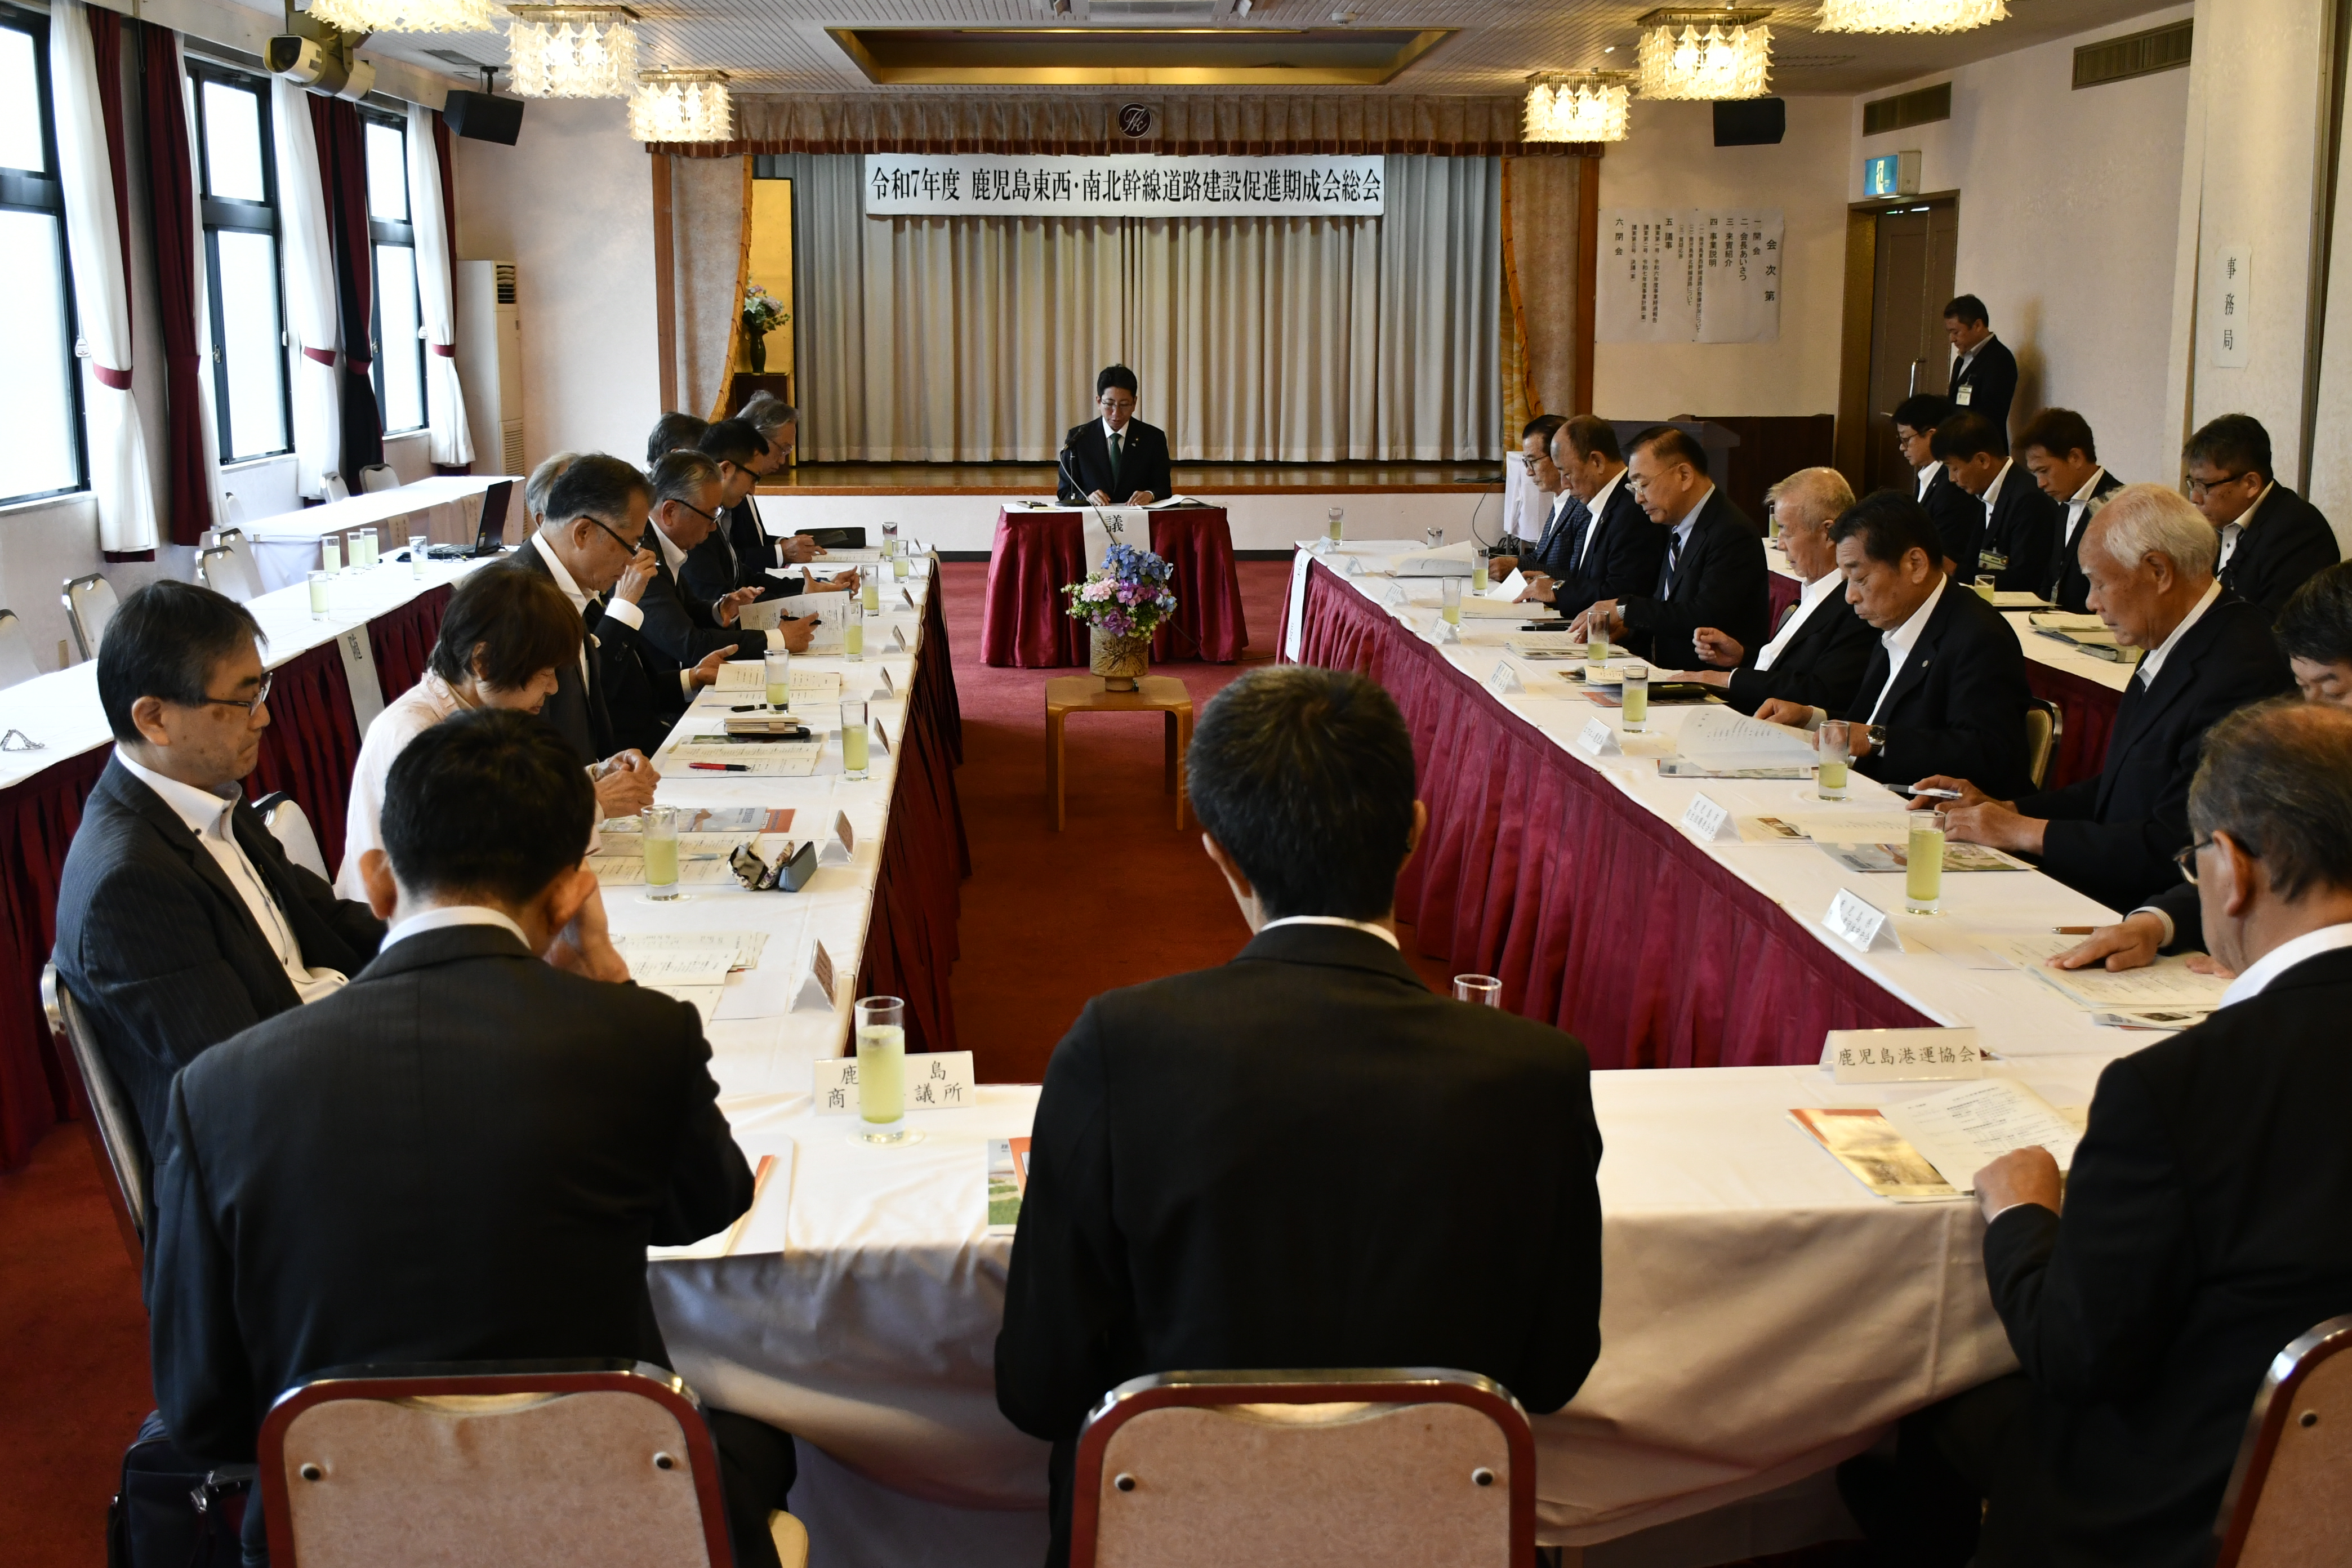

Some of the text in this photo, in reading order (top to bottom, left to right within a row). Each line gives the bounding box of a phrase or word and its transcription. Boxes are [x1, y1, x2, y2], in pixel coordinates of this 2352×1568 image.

[871, 167, 1381, 203] 令和7年度 鹿児島東西・南北幹線道路建設促進期成会総会
[2222, 257, 2237, 350] 事務局
[1837, 1046, 1976, 1066] 鹿児島港運協会
[840, 1060, 947, 1085] 鹿島
[827, 1083, 963, 1108] 商議所
